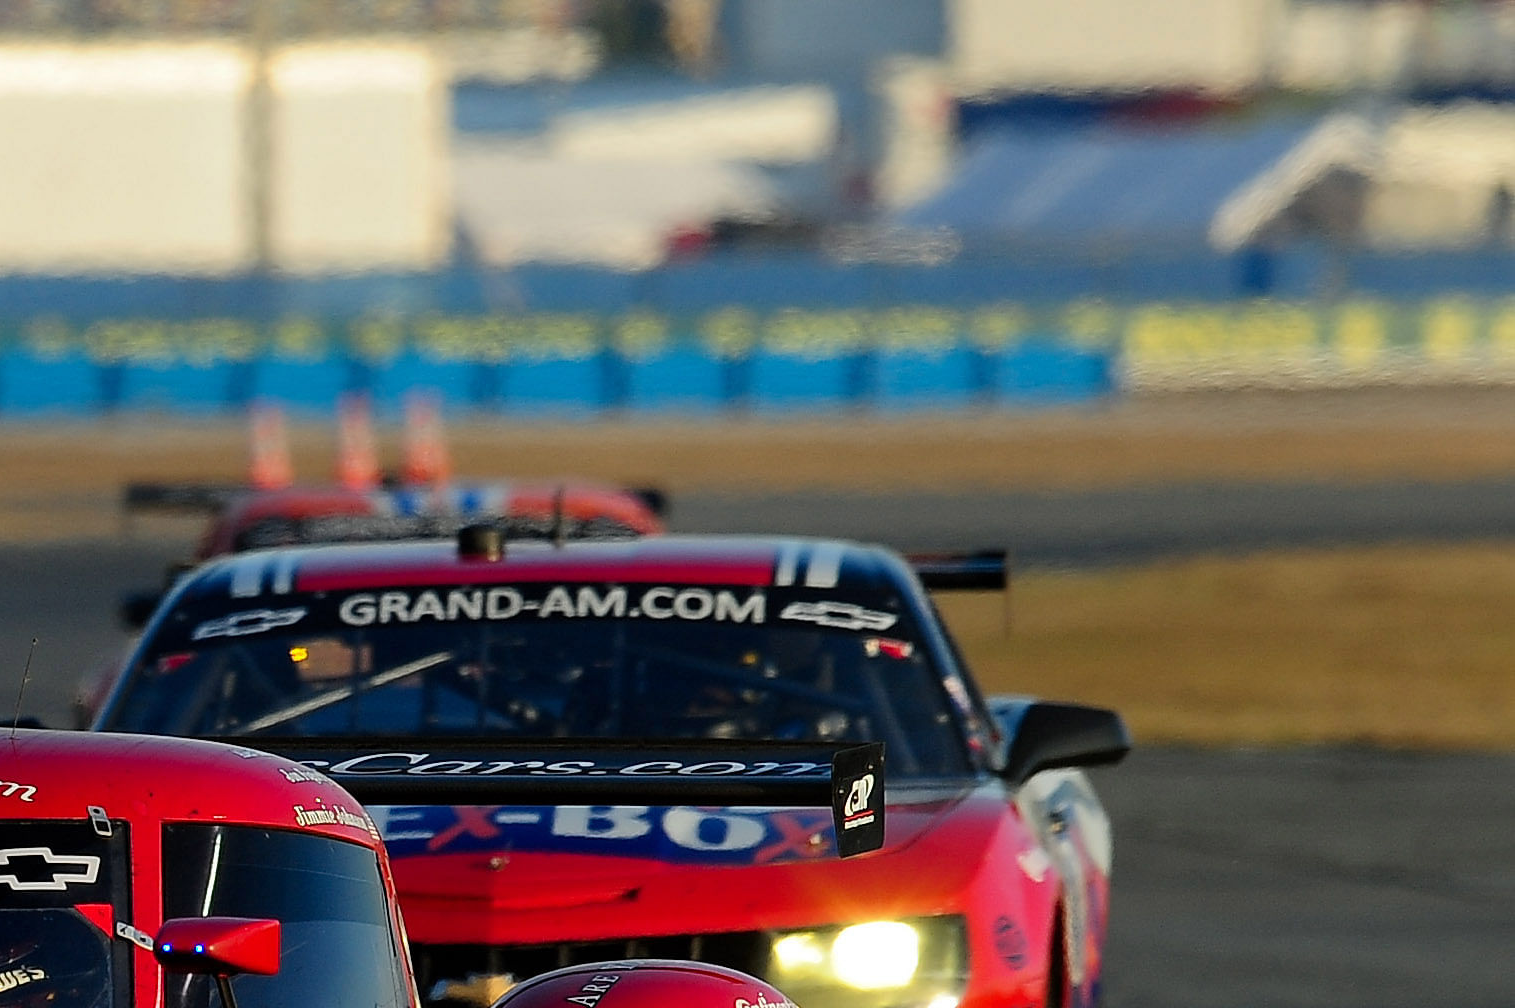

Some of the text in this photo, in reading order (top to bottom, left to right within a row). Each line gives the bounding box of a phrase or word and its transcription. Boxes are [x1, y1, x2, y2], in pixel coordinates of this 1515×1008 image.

[339, 585, 765, 627] GRAND-AM.COM
[293, 804, 337, 827] Jimmie
[567, 974, 620, 1008] ARE
